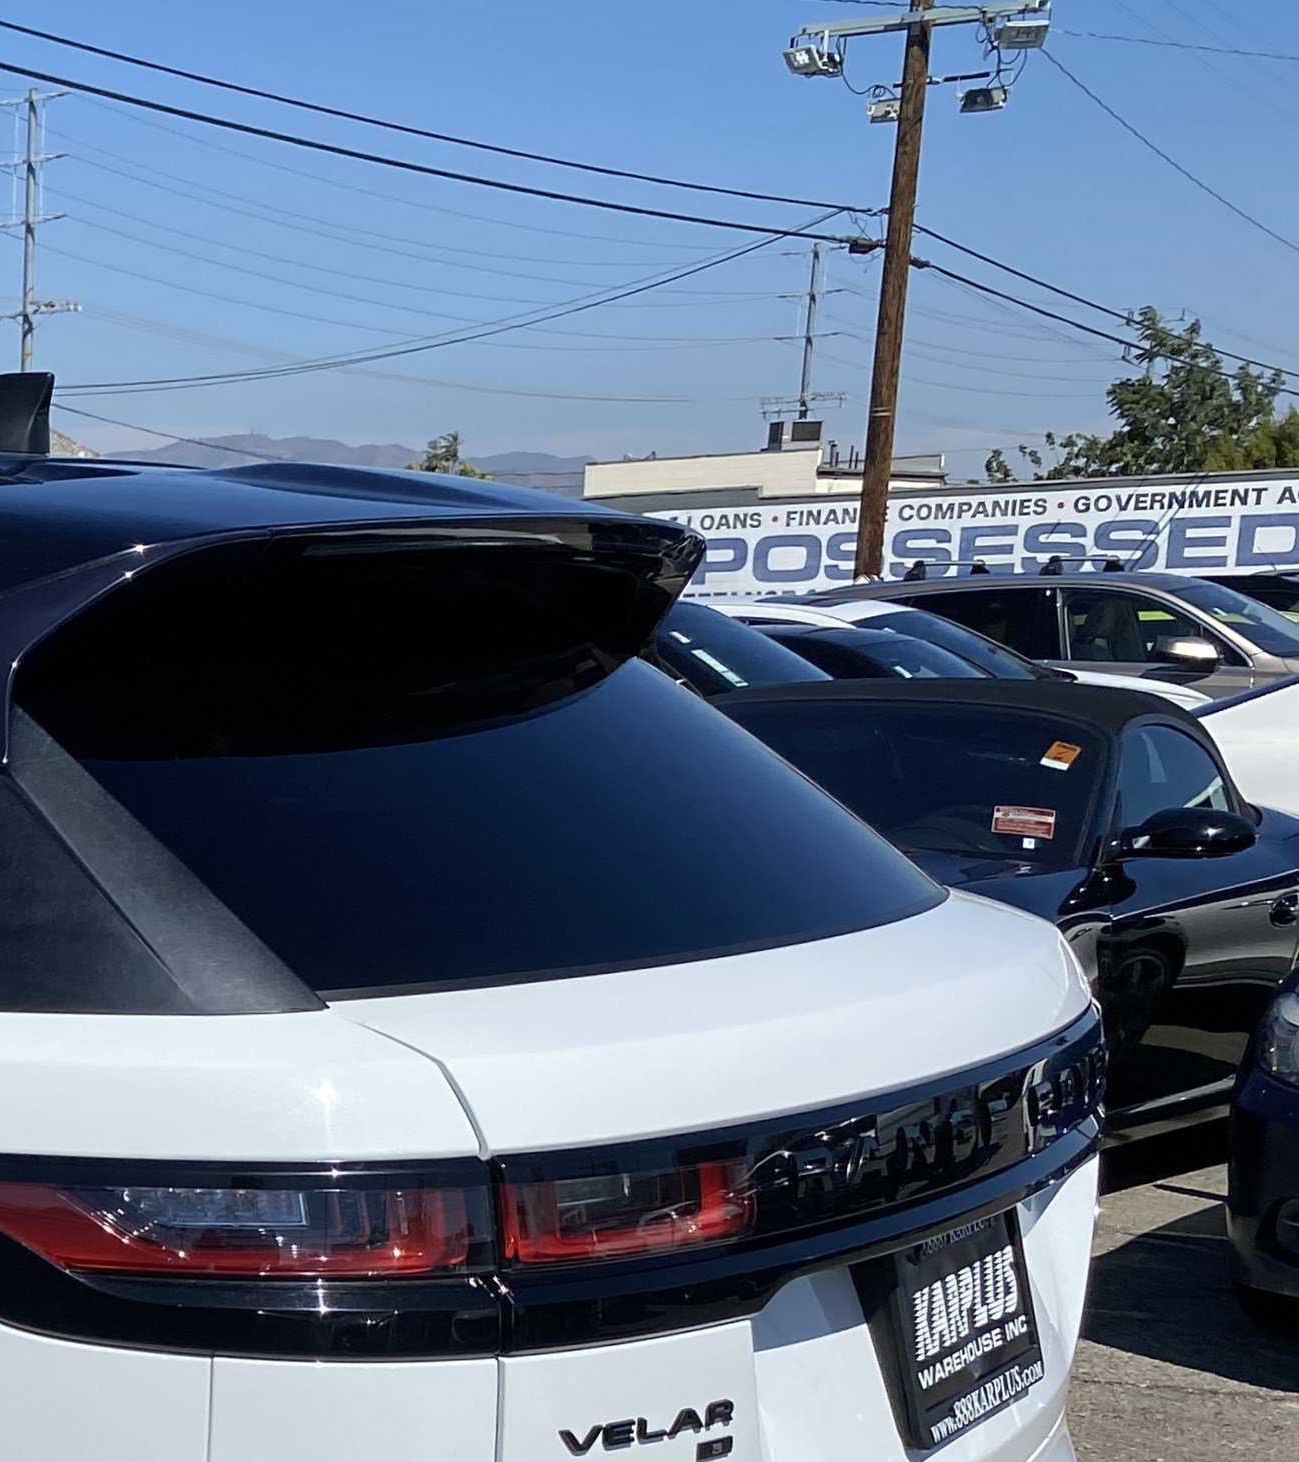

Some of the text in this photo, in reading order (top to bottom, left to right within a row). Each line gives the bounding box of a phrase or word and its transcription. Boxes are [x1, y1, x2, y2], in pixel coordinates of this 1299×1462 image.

[898, 497, 1048, 522] COMPANIES
[1073, 487, 1268, 514] GOVERNMENT
[912, 1244, 1018, 1362] KARPLUS
[918, 1314, 1028, 1390] WAREHOUSE INC
[558, 1398, 734, 1457] VELAR
